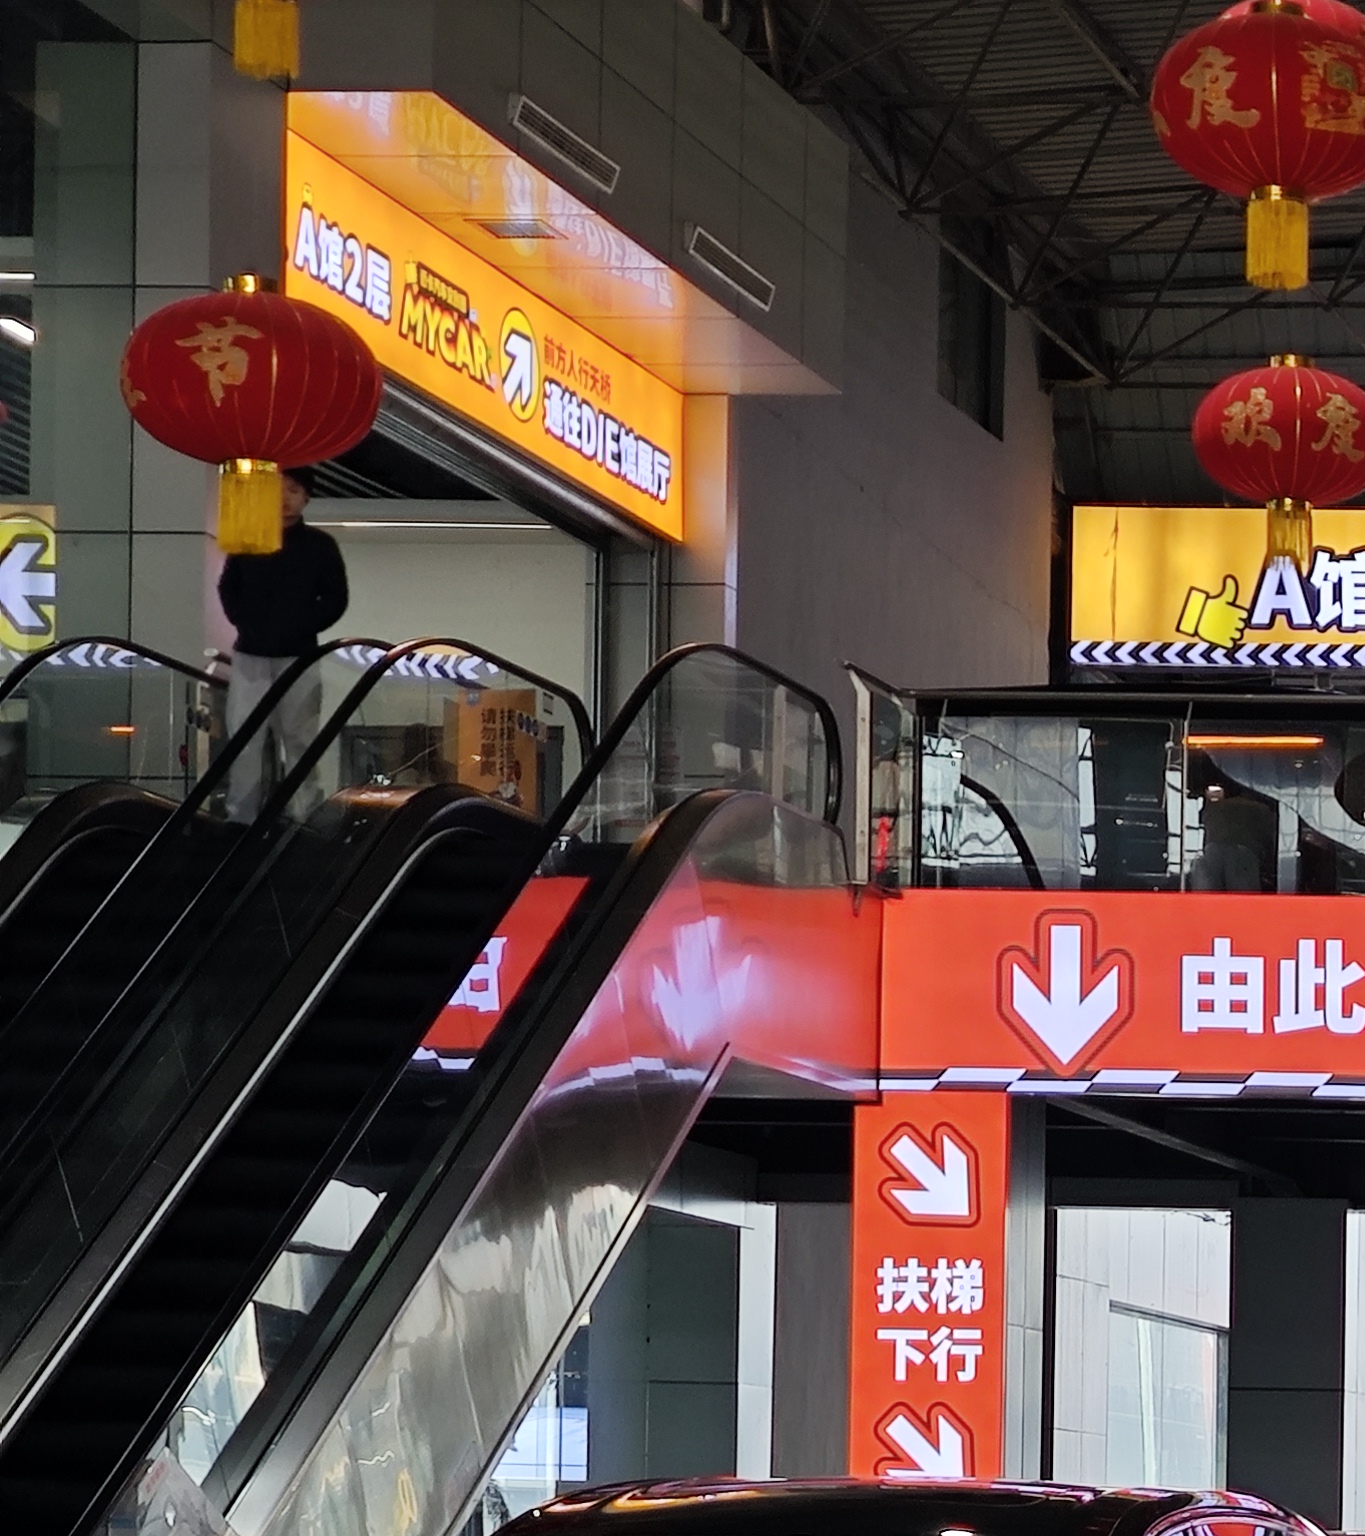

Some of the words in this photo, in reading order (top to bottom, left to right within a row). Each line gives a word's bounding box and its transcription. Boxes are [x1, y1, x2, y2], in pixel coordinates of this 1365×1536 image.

[294, 205, 391, 323] A馆2层
[399, 284, 495, 392] MYCAR
[543, 334, 612, 404] 前方人行天桥
[876, 1257, 985, 1315] 扶梯
[876, 1327, 983, 1383] 下行
